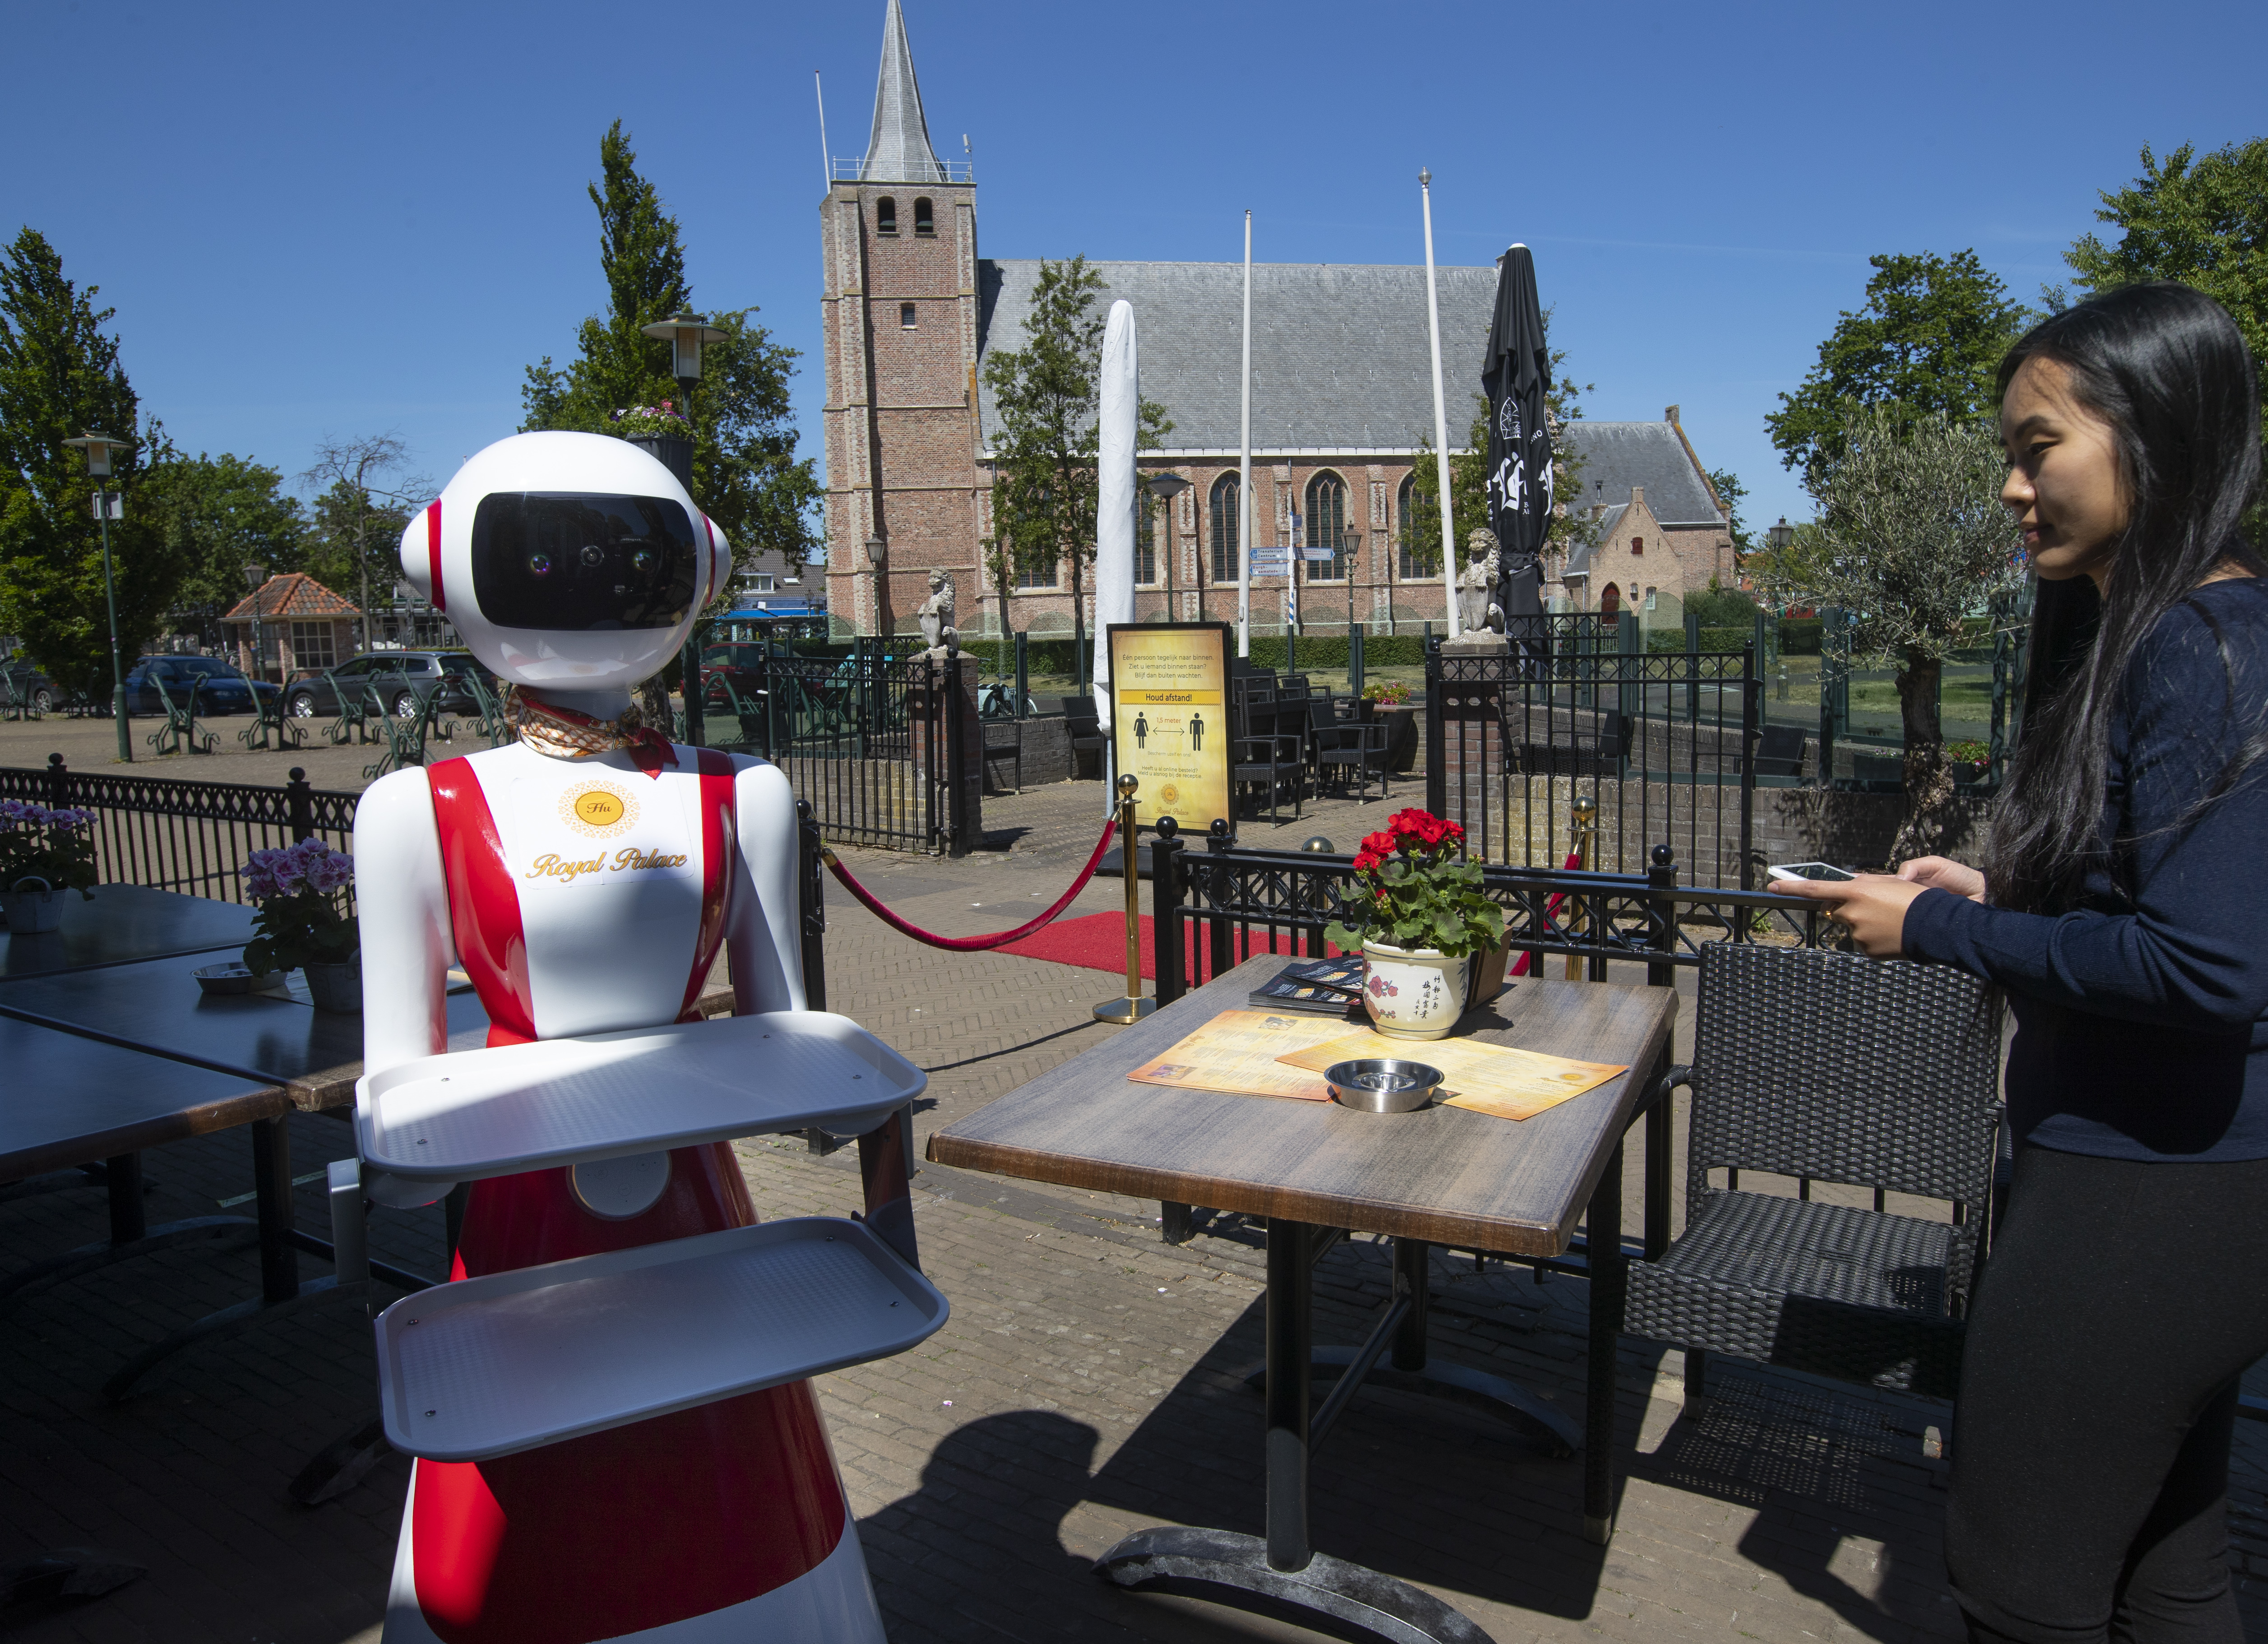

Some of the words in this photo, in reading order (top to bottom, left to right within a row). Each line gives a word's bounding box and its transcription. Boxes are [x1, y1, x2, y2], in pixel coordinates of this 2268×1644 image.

[586, 802, 612, 814] Hu
[1155, 807, 1171, 815] Royal
[525, 852, 607, 883] Royal
[610, 847, 688, 871] Palace
